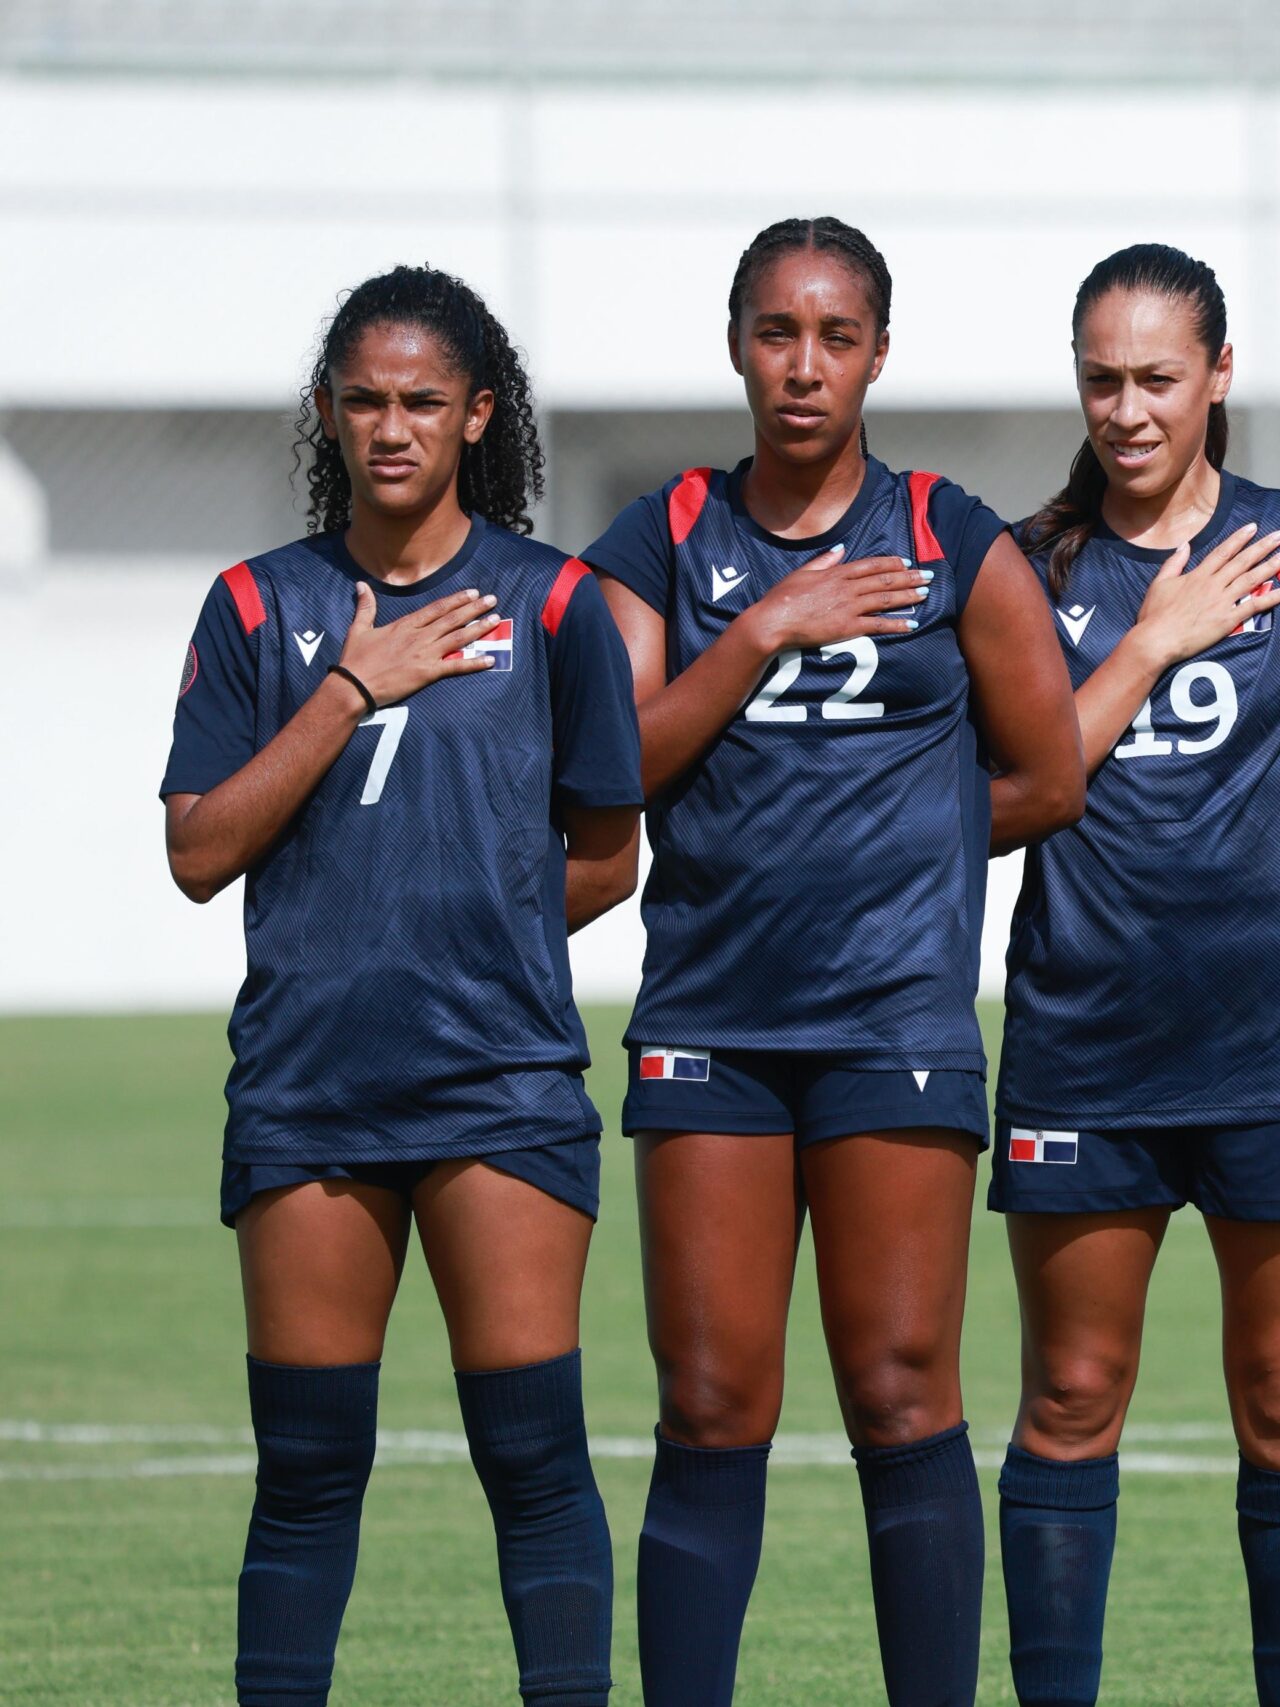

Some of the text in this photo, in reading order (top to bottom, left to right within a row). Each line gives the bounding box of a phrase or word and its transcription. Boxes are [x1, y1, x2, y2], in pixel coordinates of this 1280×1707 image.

[744, 635, 885, 722] 22
[1114, 660, 1239, 759] 19
[358, 705, 409, 805] 7
